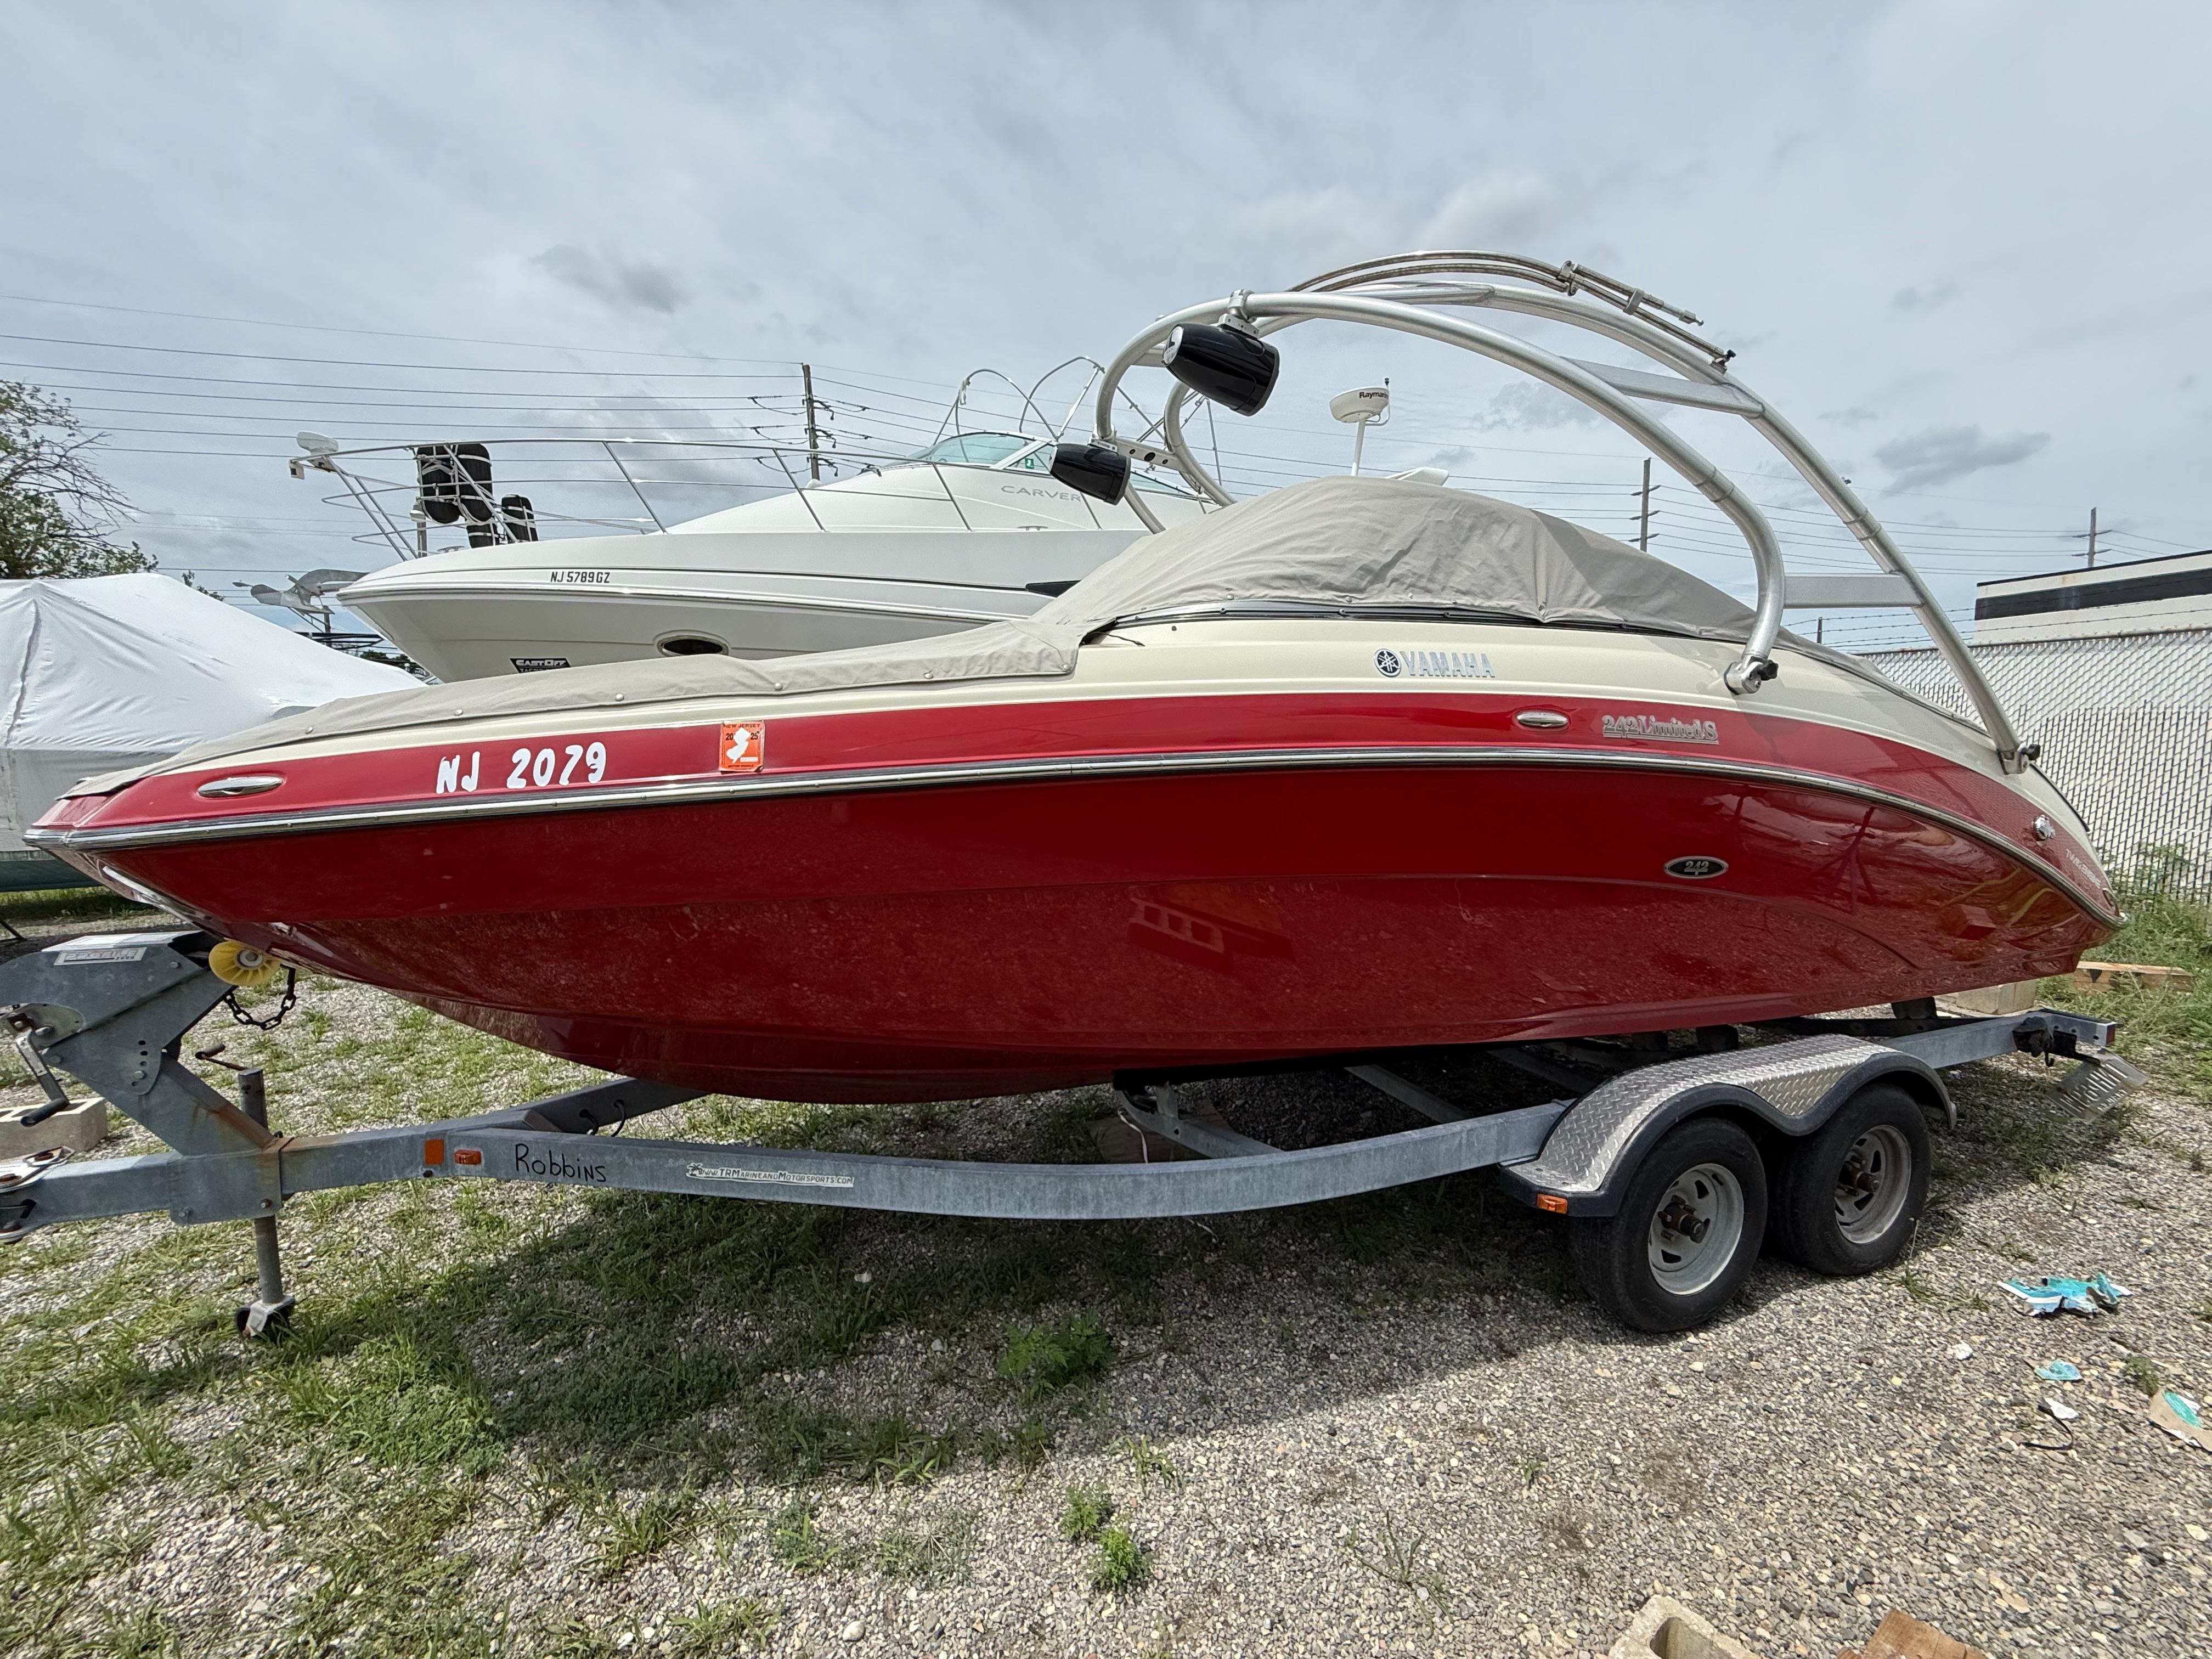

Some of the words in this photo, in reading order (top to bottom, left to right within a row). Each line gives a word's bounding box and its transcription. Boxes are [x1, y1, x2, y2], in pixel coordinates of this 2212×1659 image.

[1001, 486, 1081, 502] CARVER
[550, 571, 565, 583] NJ
[566, 571, 595, 583] 5789
[596, 572, 610, 583] GZ
[1399, 651, 1495, 678] YAMAHA
[1602, 715, 1638, 738] 242
[1638, 715, 1701, 739] Limited
[1702, 720, 1718, 741] S
[725, 732, 733, 741] 20
[436, 751, 480, 794] NJ
[507, 742, 606, 789] 2079
[1684, 861, 1709, 875] 242
[63, 950, 138, 961] PROFILE
[515, 1143, 606, 1182] Robbins
